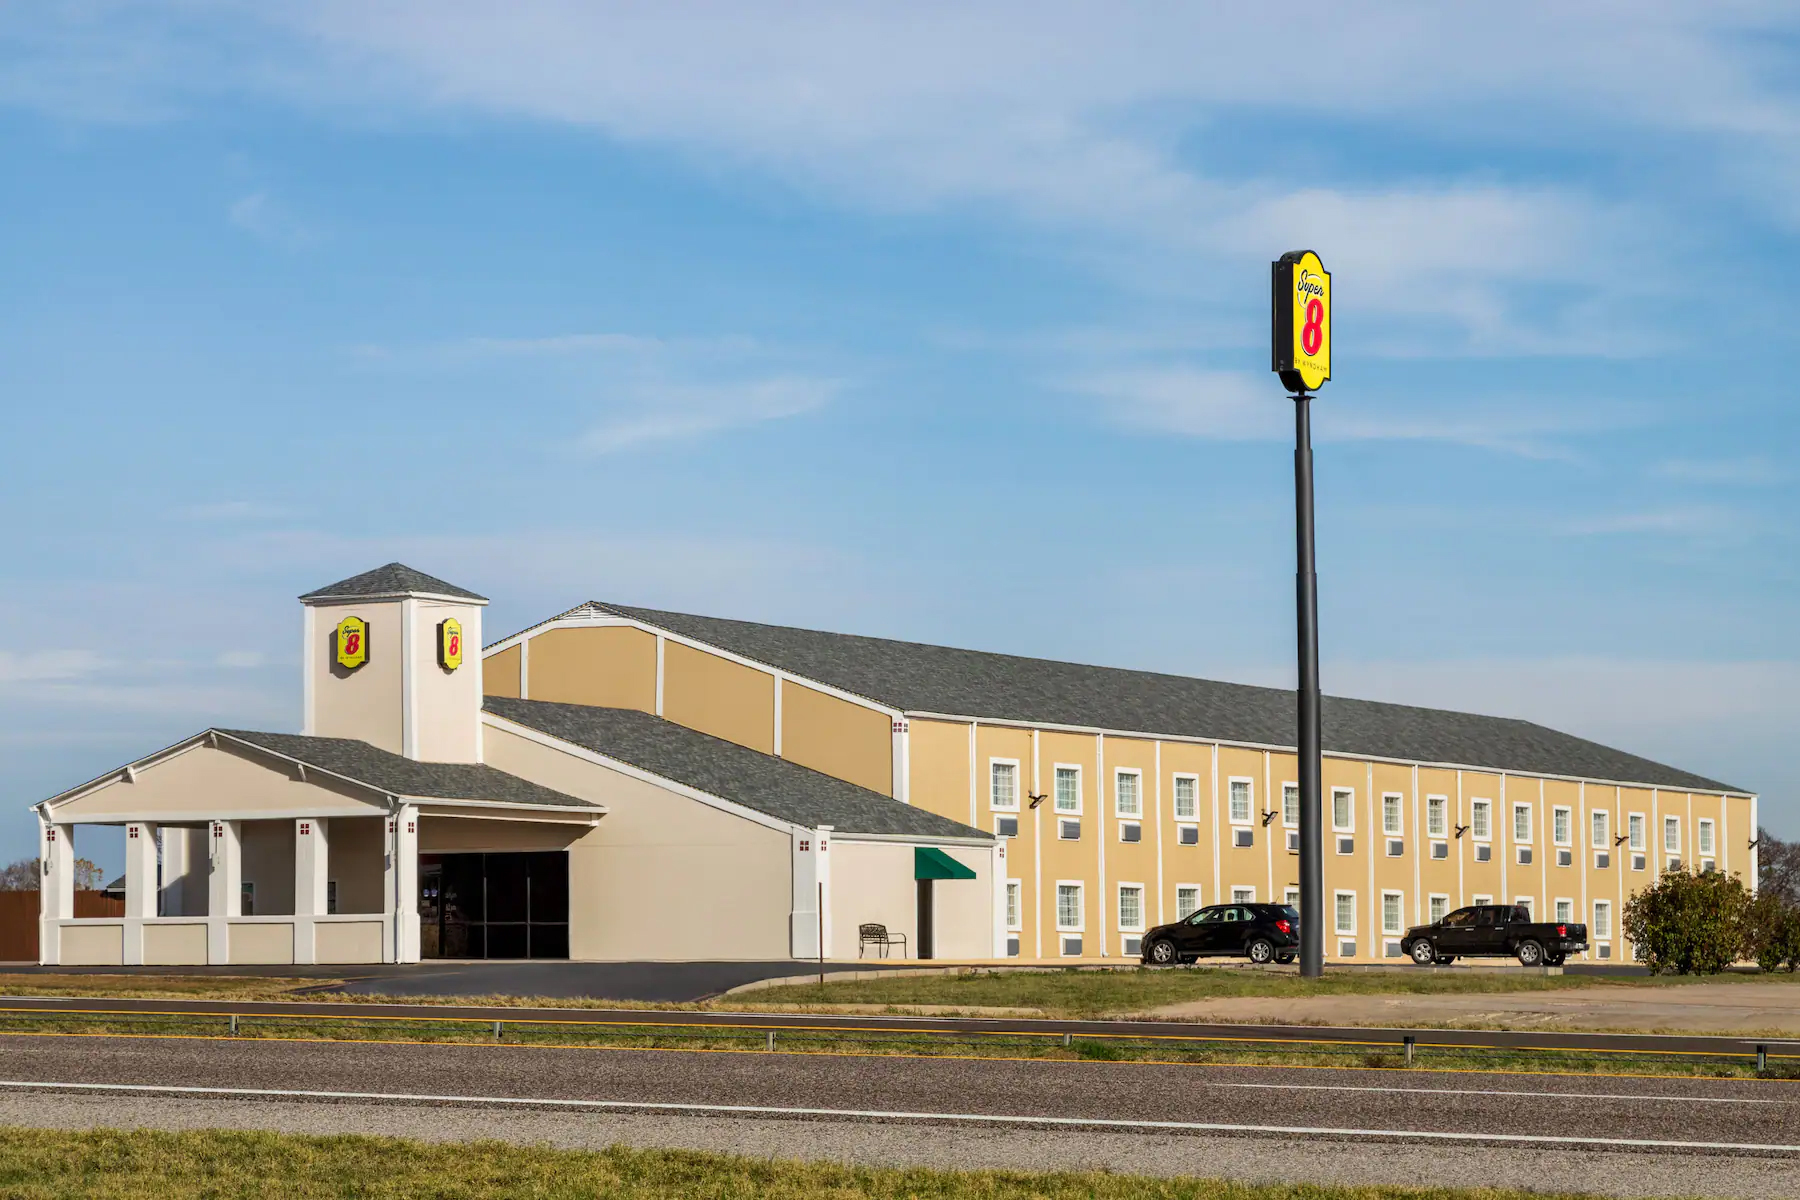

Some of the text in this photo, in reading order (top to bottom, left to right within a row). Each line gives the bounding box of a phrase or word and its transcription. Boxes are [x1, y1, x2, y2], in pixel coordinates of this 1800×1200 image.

[1297, 269, 1324, 304] Super
[1301, 298, 1324, 356] 8
[342, 625, 360, 638] Super
[344, 633, 360, 655] 8
[449, 635, 459, 656] 8
